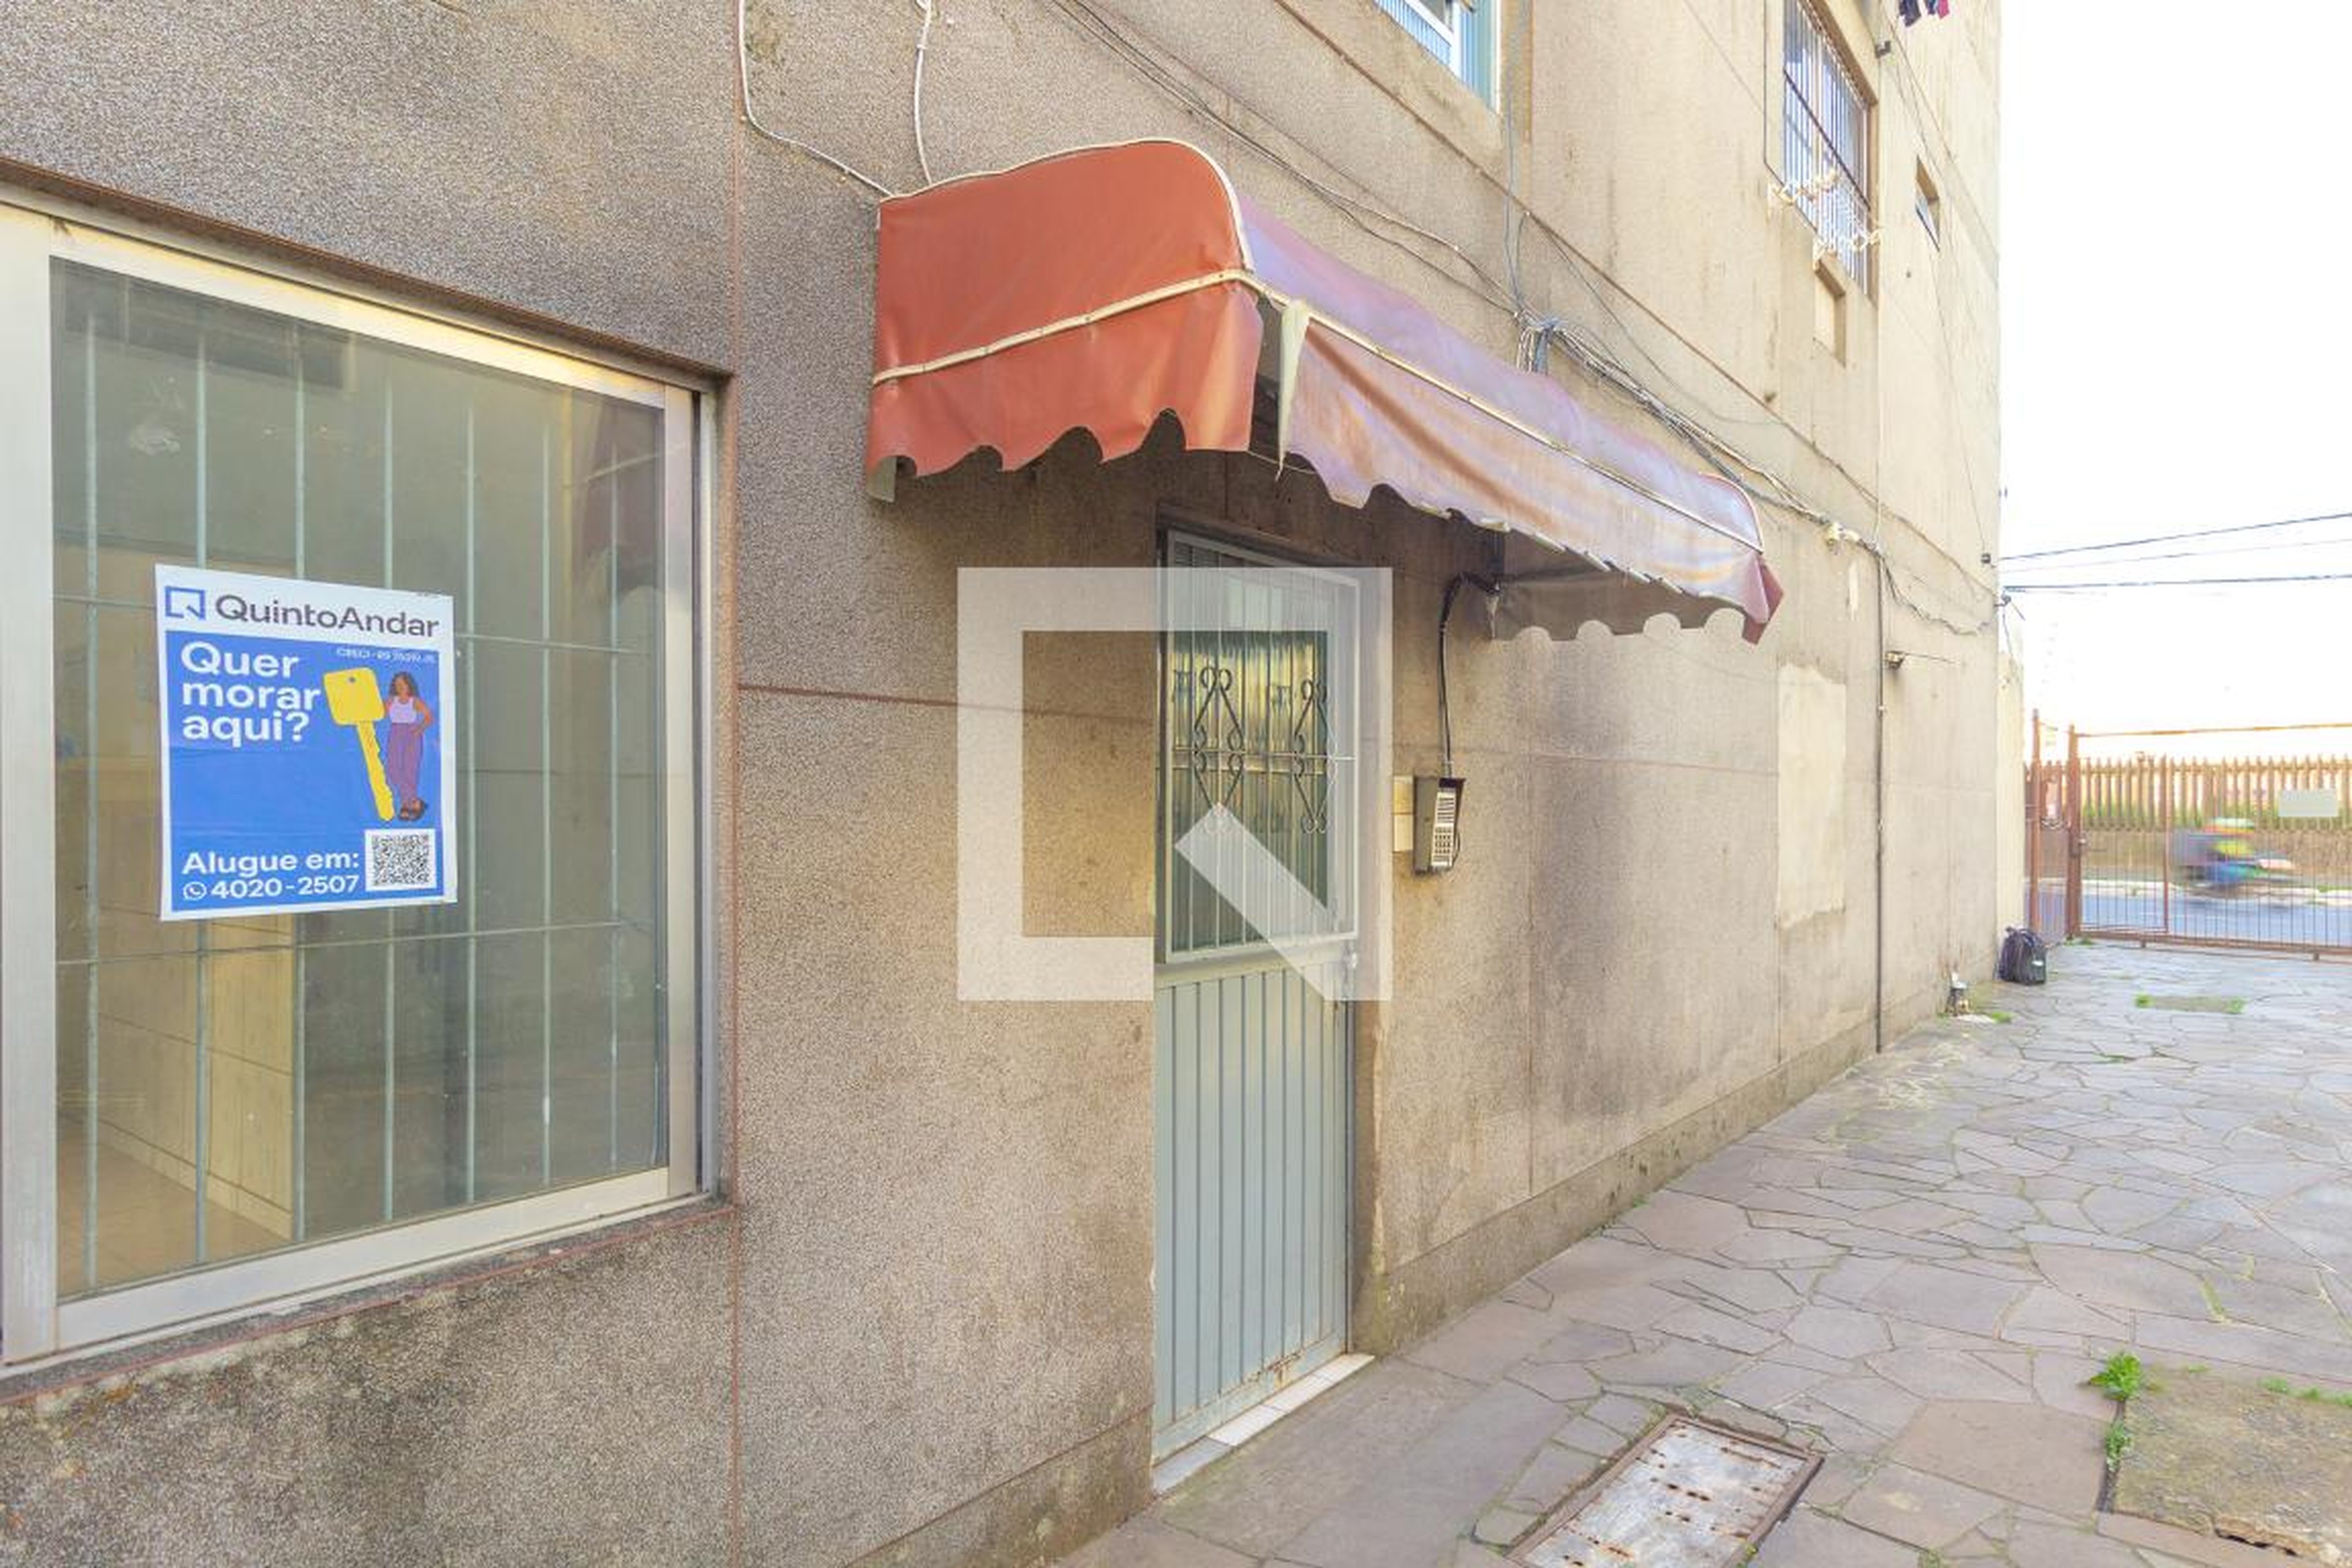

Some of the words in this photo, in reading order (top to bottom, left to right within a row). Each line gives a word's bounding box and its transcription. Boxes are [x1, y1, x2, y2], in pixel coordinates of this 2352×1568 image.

[215, 594, 440, 637] QuintoAndar
[181, 641, 300, 676] Quer
[183, 681, 322, 711] morar
[183, 712, 309, 748] aqui?
[182, 852, 297, 876] Alugue
[306, 852, 360, 869] em:
